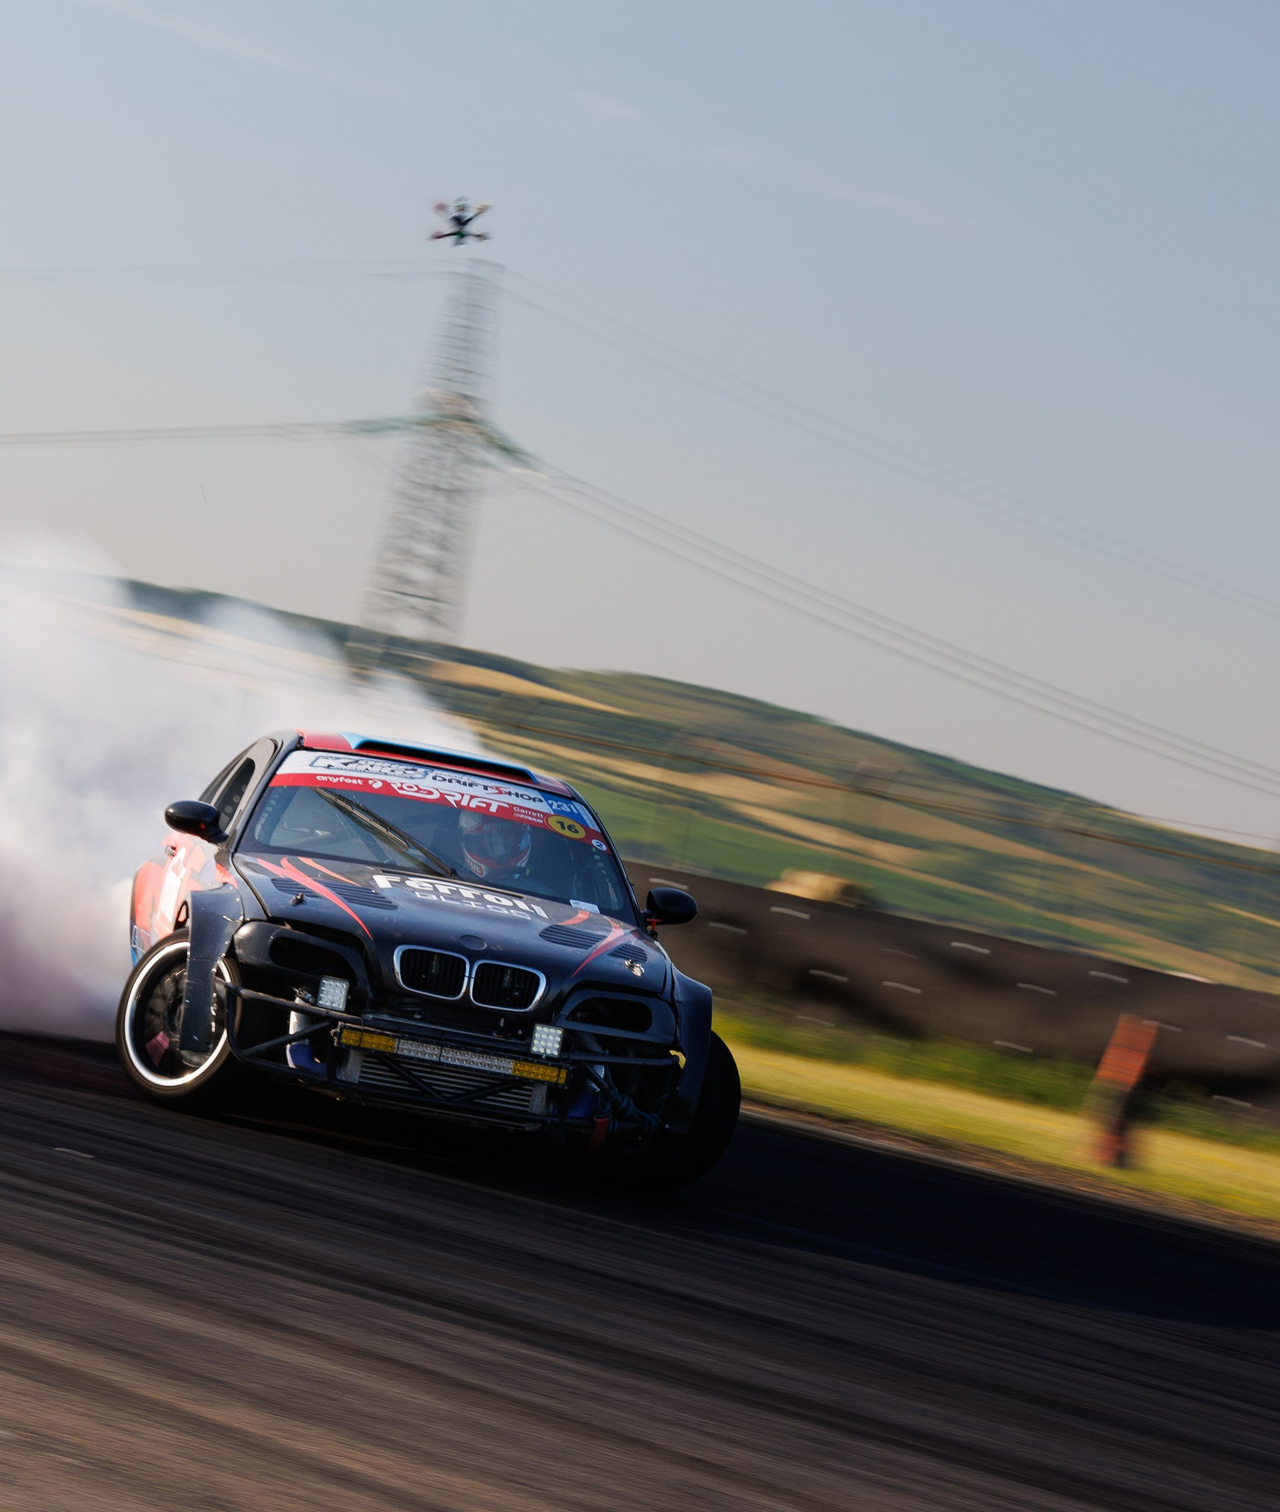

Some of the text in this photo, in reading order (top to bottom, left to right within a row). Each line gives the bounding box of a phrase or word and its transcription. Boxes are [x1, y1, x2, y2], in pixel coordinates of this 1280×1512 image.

[316, 775, 363, 786] anyfest
[548, 799, 579, 814] 231
[556, 820, 580, 834] 16
[372, 875, 549, 919] Ferroli
